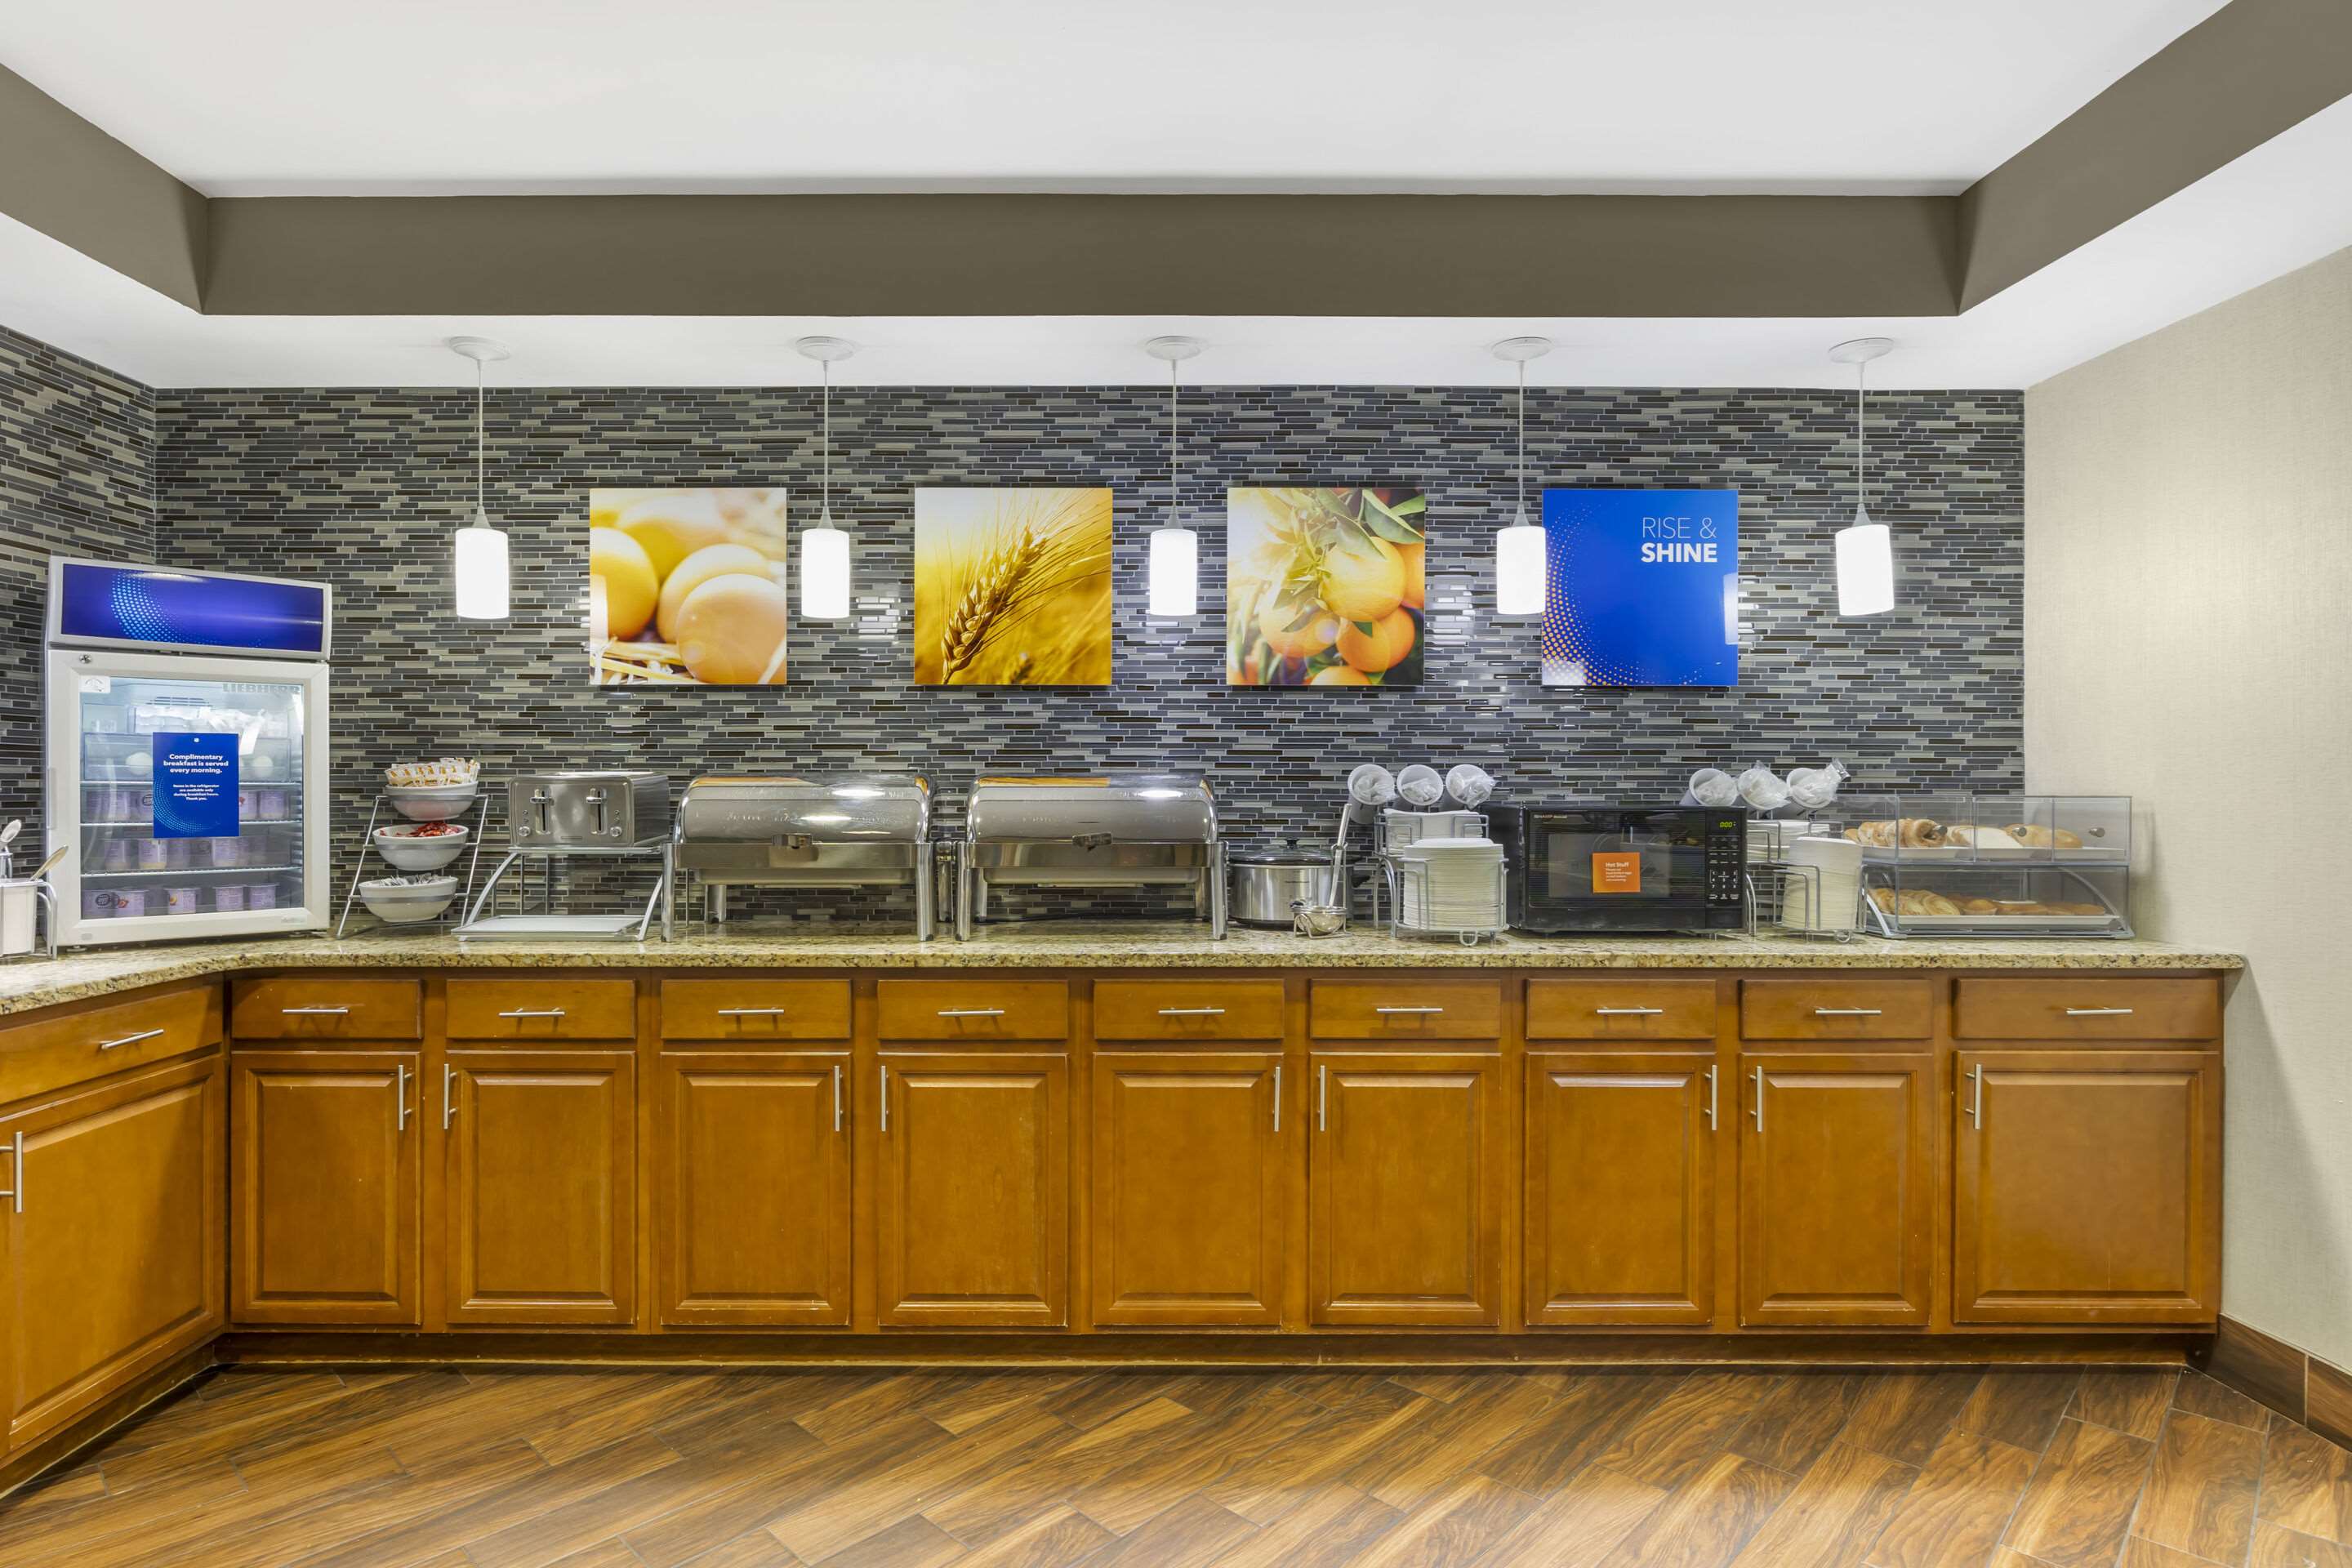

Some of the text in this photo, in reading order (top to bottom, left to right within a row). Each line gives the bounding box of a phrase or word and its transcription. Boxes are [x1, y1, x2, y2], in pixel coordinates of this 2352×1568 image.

[1642, 516, 1717, 539] RISE &
[1641, 542, 1718, 563] SHINE
